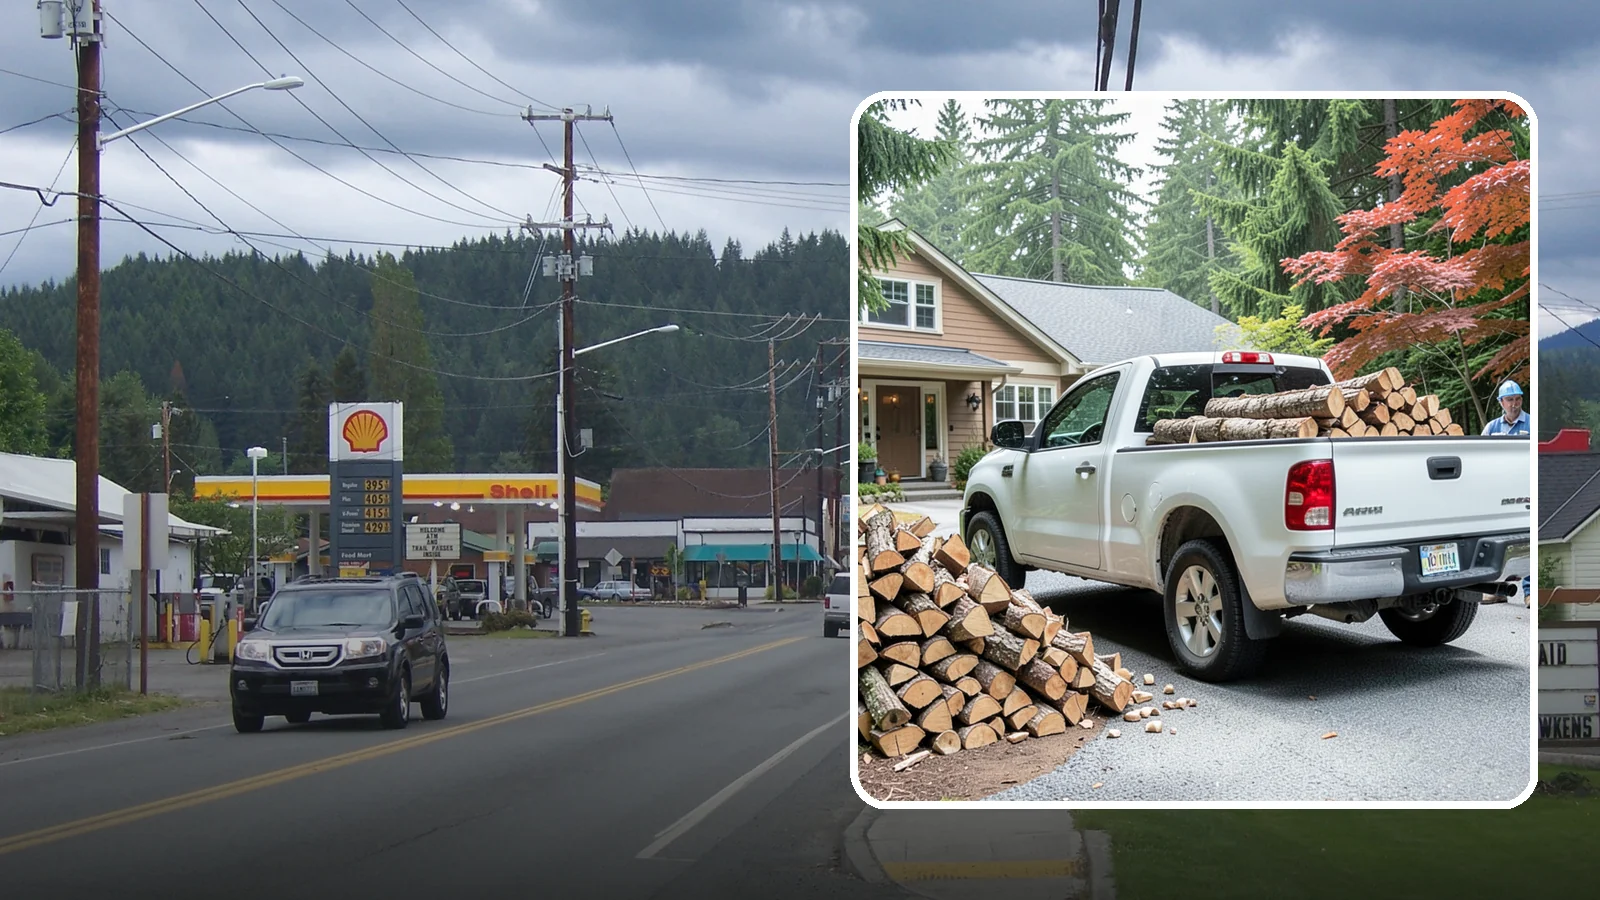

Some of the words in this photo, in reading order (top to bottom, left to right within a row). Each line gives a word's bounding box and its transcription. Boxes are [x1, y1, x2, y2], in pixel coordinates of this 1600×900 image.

[366, 480, 383, 490] 395
[490, 484, 547, 499] Shell
[365, 494, 383, 504] 405
[365, 508, 383, 518] 415
[366, 522, 383, 532] 429
